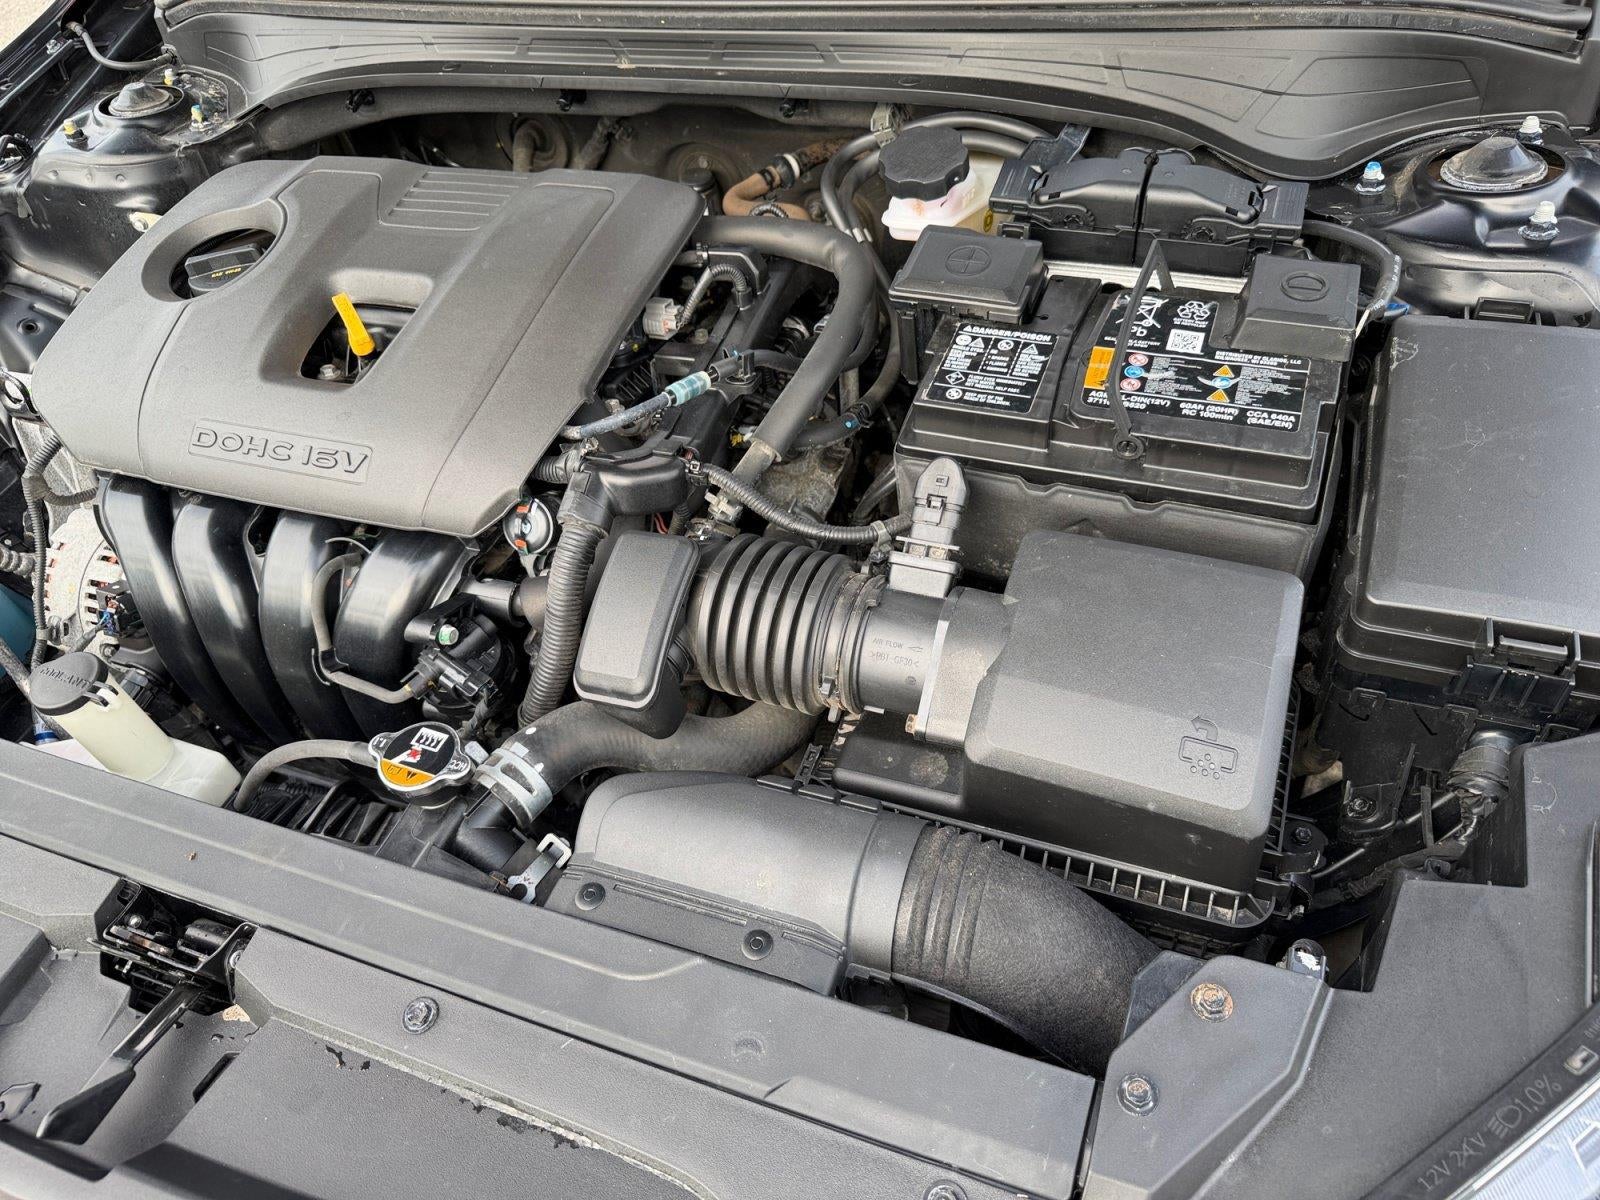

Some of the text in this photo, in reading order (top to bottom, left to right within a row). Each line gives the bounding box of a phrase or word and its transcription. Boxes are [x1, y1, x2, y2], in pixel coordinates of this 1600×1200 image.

[971, 326, 1052, 342] DANGER/POISON
[1179, 402, 1239, 416] 60Ah (20HR)
[1181, 408, 1234, 421] RC 100min
[1246, 410, 1269, 420] CCA
[1247, 417, 1293, 430] (SAE/EN)
[191, 426, 369, 474] DOHC 16V
[1416, 1159, 1451, 1193] 12V
